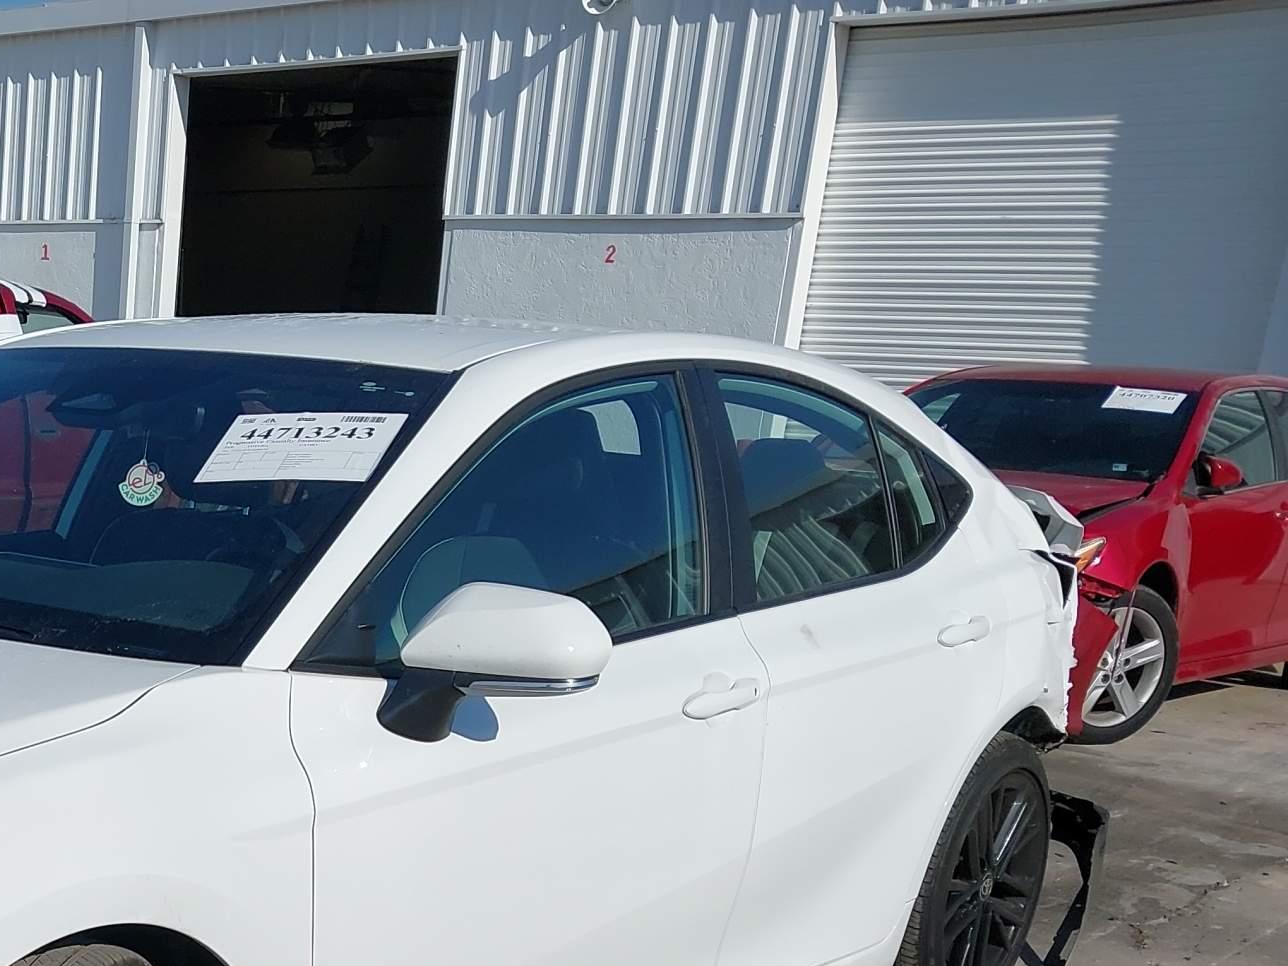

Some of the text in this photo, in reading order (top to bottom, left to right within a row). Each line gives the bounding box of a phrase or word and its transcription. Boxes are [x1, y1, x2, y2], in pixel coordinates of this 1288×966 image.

[40, 243, 50, 261] 1
[604, 244, 617, 264] 2
[240, 426, 376, 441] 44713243
[120, 483, 161, 504] CAR WASH
